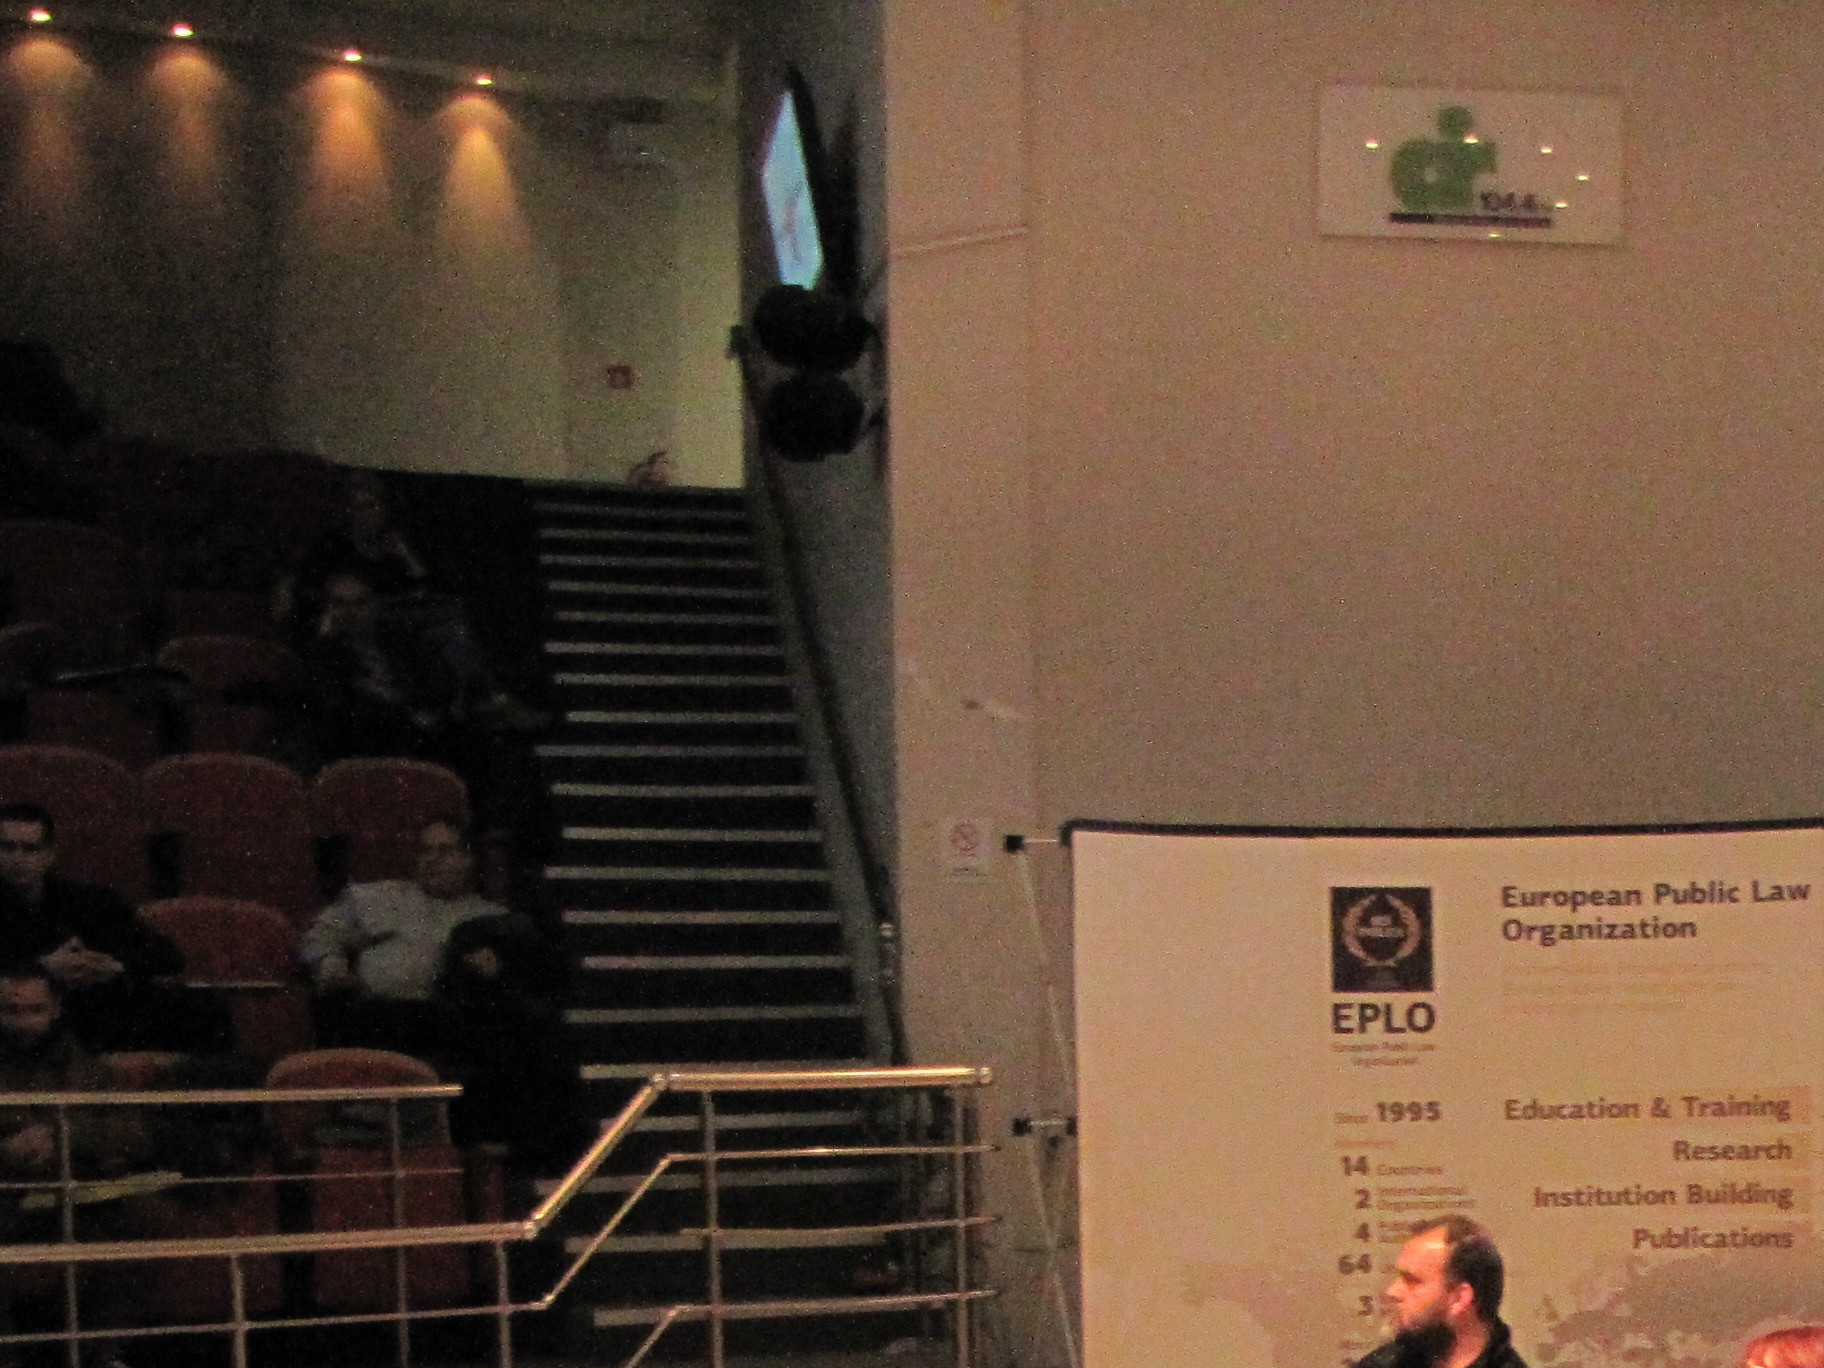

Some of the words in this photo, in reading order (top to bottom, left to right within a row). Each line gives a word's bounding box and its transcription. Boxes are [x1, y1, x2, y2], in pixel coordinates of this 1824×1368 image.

[1502, 885, 1641, 910] European
[1654, 882, 1740, 905] Public
[1751, 880, 1811, 903] Law
[1502, 917, 1698, 946] Organization
[1332, 1002, 1436, 1035] EPLO
[1376, 1101, 1441, 1122] 1995
[1504, 1097, 1639, 1120] Education
[1651, 1097, 1671, 1119] &
[1682, 1094, 1792, 1124] Training
[1673, 1138, 1793, 1162] Research
[1340, 1156, 1369, 1176] 14
[1354, 1188, 1371, 1210] 2
[1534, 1184, 1677, 1209] Institution
[1686, 1182, 1794, 1213] Building
[1353, 1223, 1370, 1243] 4
[1632, 1227, 1794, 1252] Publications
[1339, 1253, 1372, 1275] 64
[1357, 1295, 1373, 1316] 3
